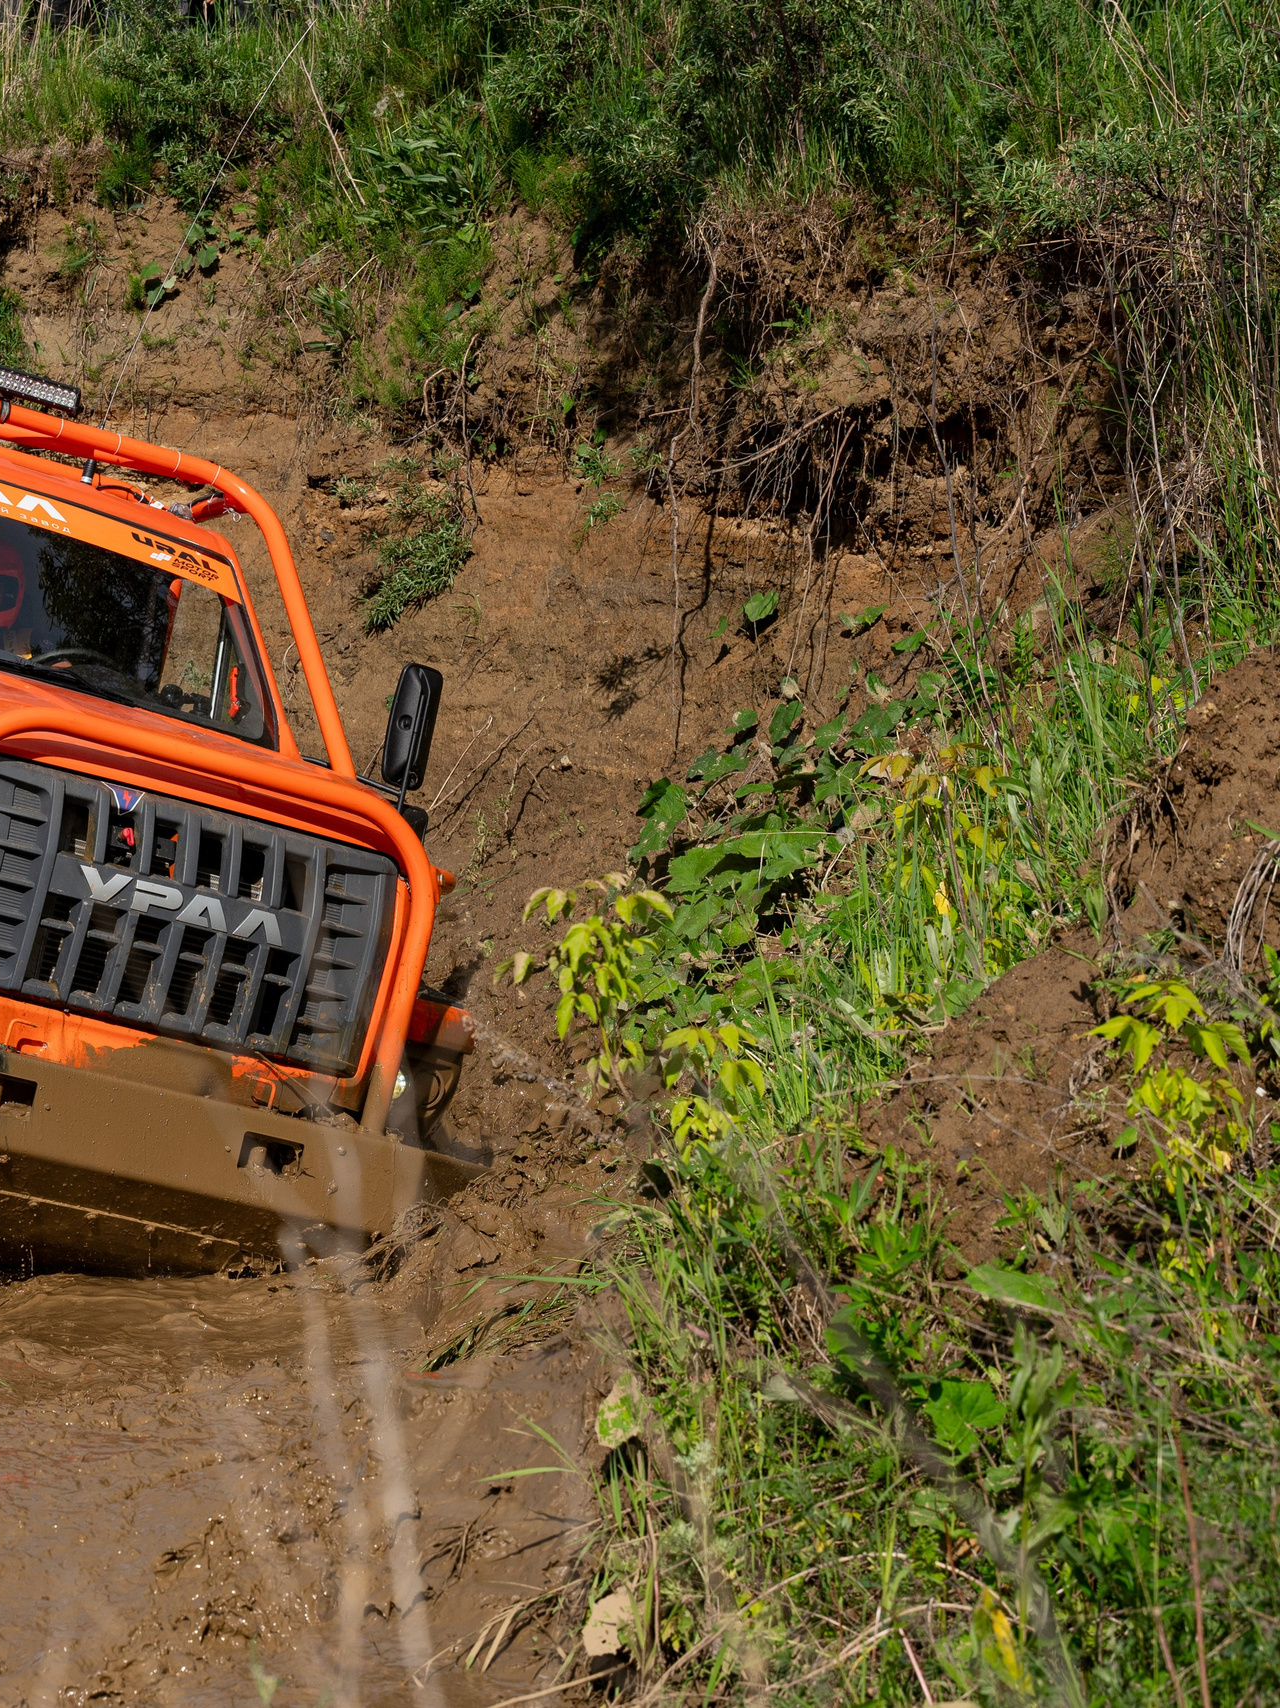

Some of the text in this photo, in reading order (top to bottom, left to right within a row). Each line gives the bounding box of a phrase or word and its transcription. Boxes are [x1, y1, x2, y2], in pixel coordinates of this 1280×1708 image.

[19, 513, 71, 534] завод
[131, 532, 218, 574] URAL
[171, 562, 215, 582] SPORT
[174, 558, 219, 580] MOTOR
[80, 864, 283, 947] УРАЛ
